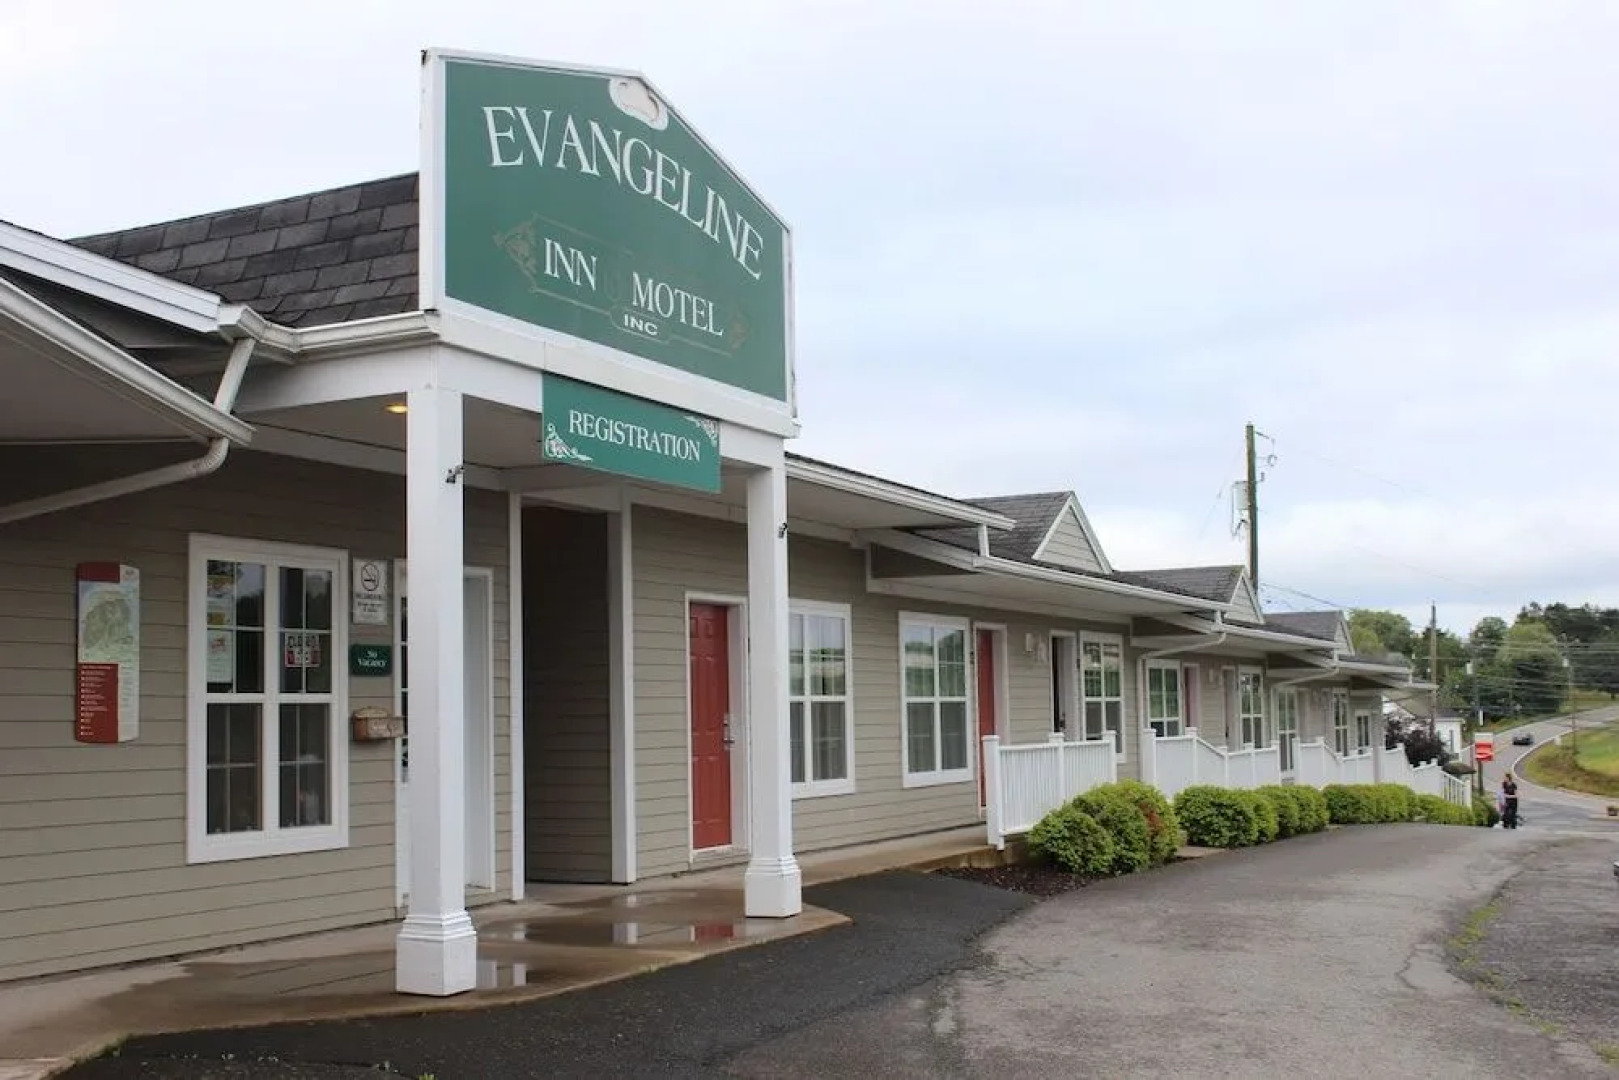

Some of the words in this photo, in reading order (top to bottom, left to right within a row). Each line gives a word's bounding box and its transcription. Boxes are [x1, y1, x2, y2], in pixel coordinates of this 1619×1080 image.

[483, 106, 763, 280] EVANGELINE
[543, 238, 597, 291] INN
[632, 273, 724, 337] MOTEL
[624, 313, 658, 336] INC
[568, 409, 700, 462] REGISTRATION
